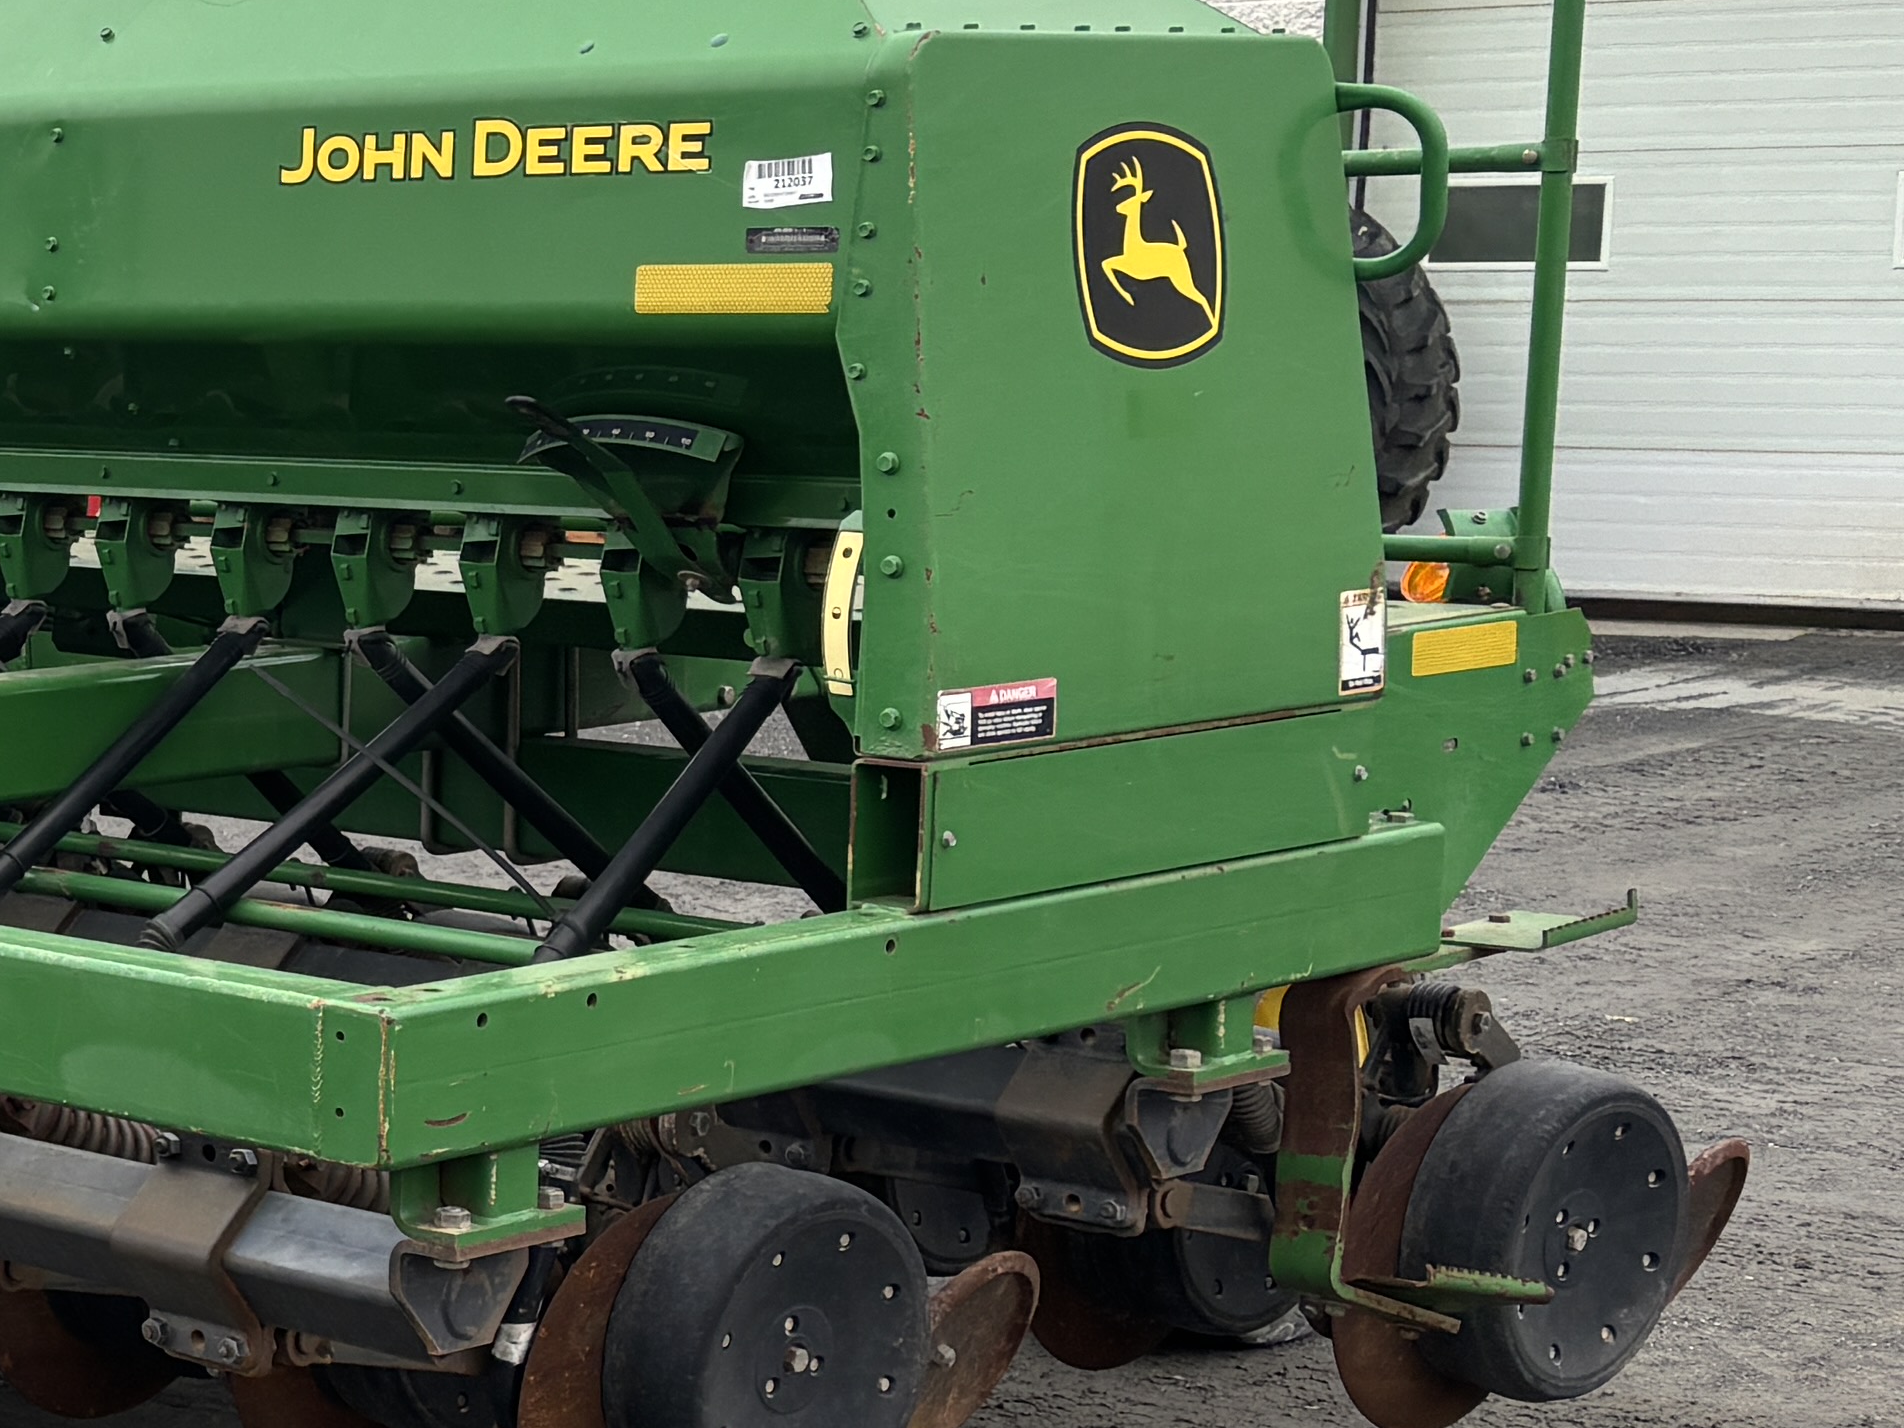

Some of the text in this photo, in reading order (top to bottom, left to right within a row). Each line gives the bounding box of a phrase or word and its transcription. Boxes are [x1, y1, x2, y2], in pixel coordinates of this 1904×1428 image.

[280, 118, 713, 185] JOHN DEERE
[999, 685, 1037, 704] DANGER
